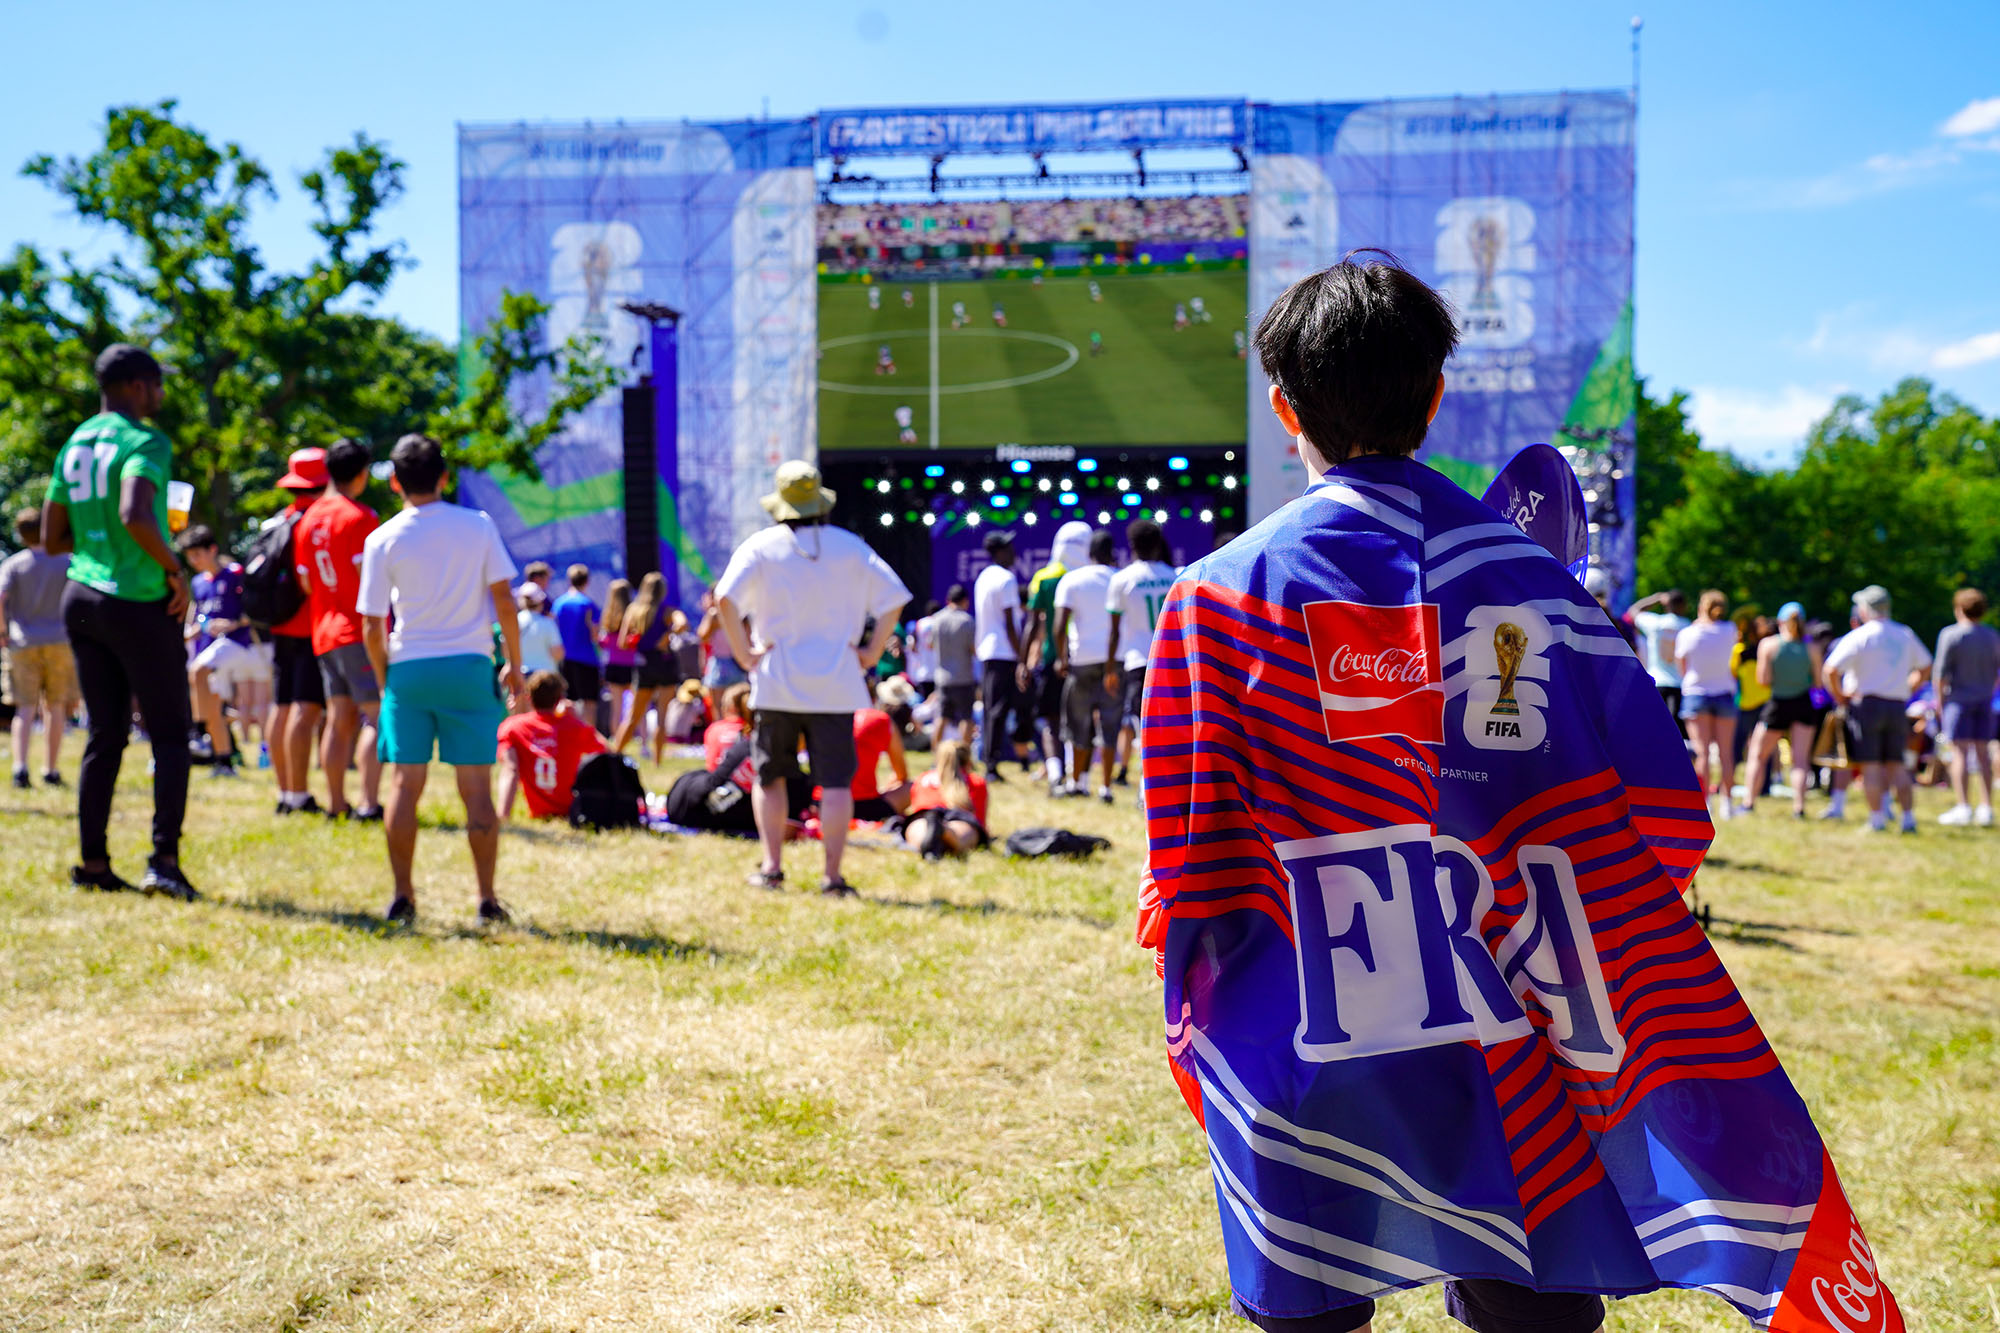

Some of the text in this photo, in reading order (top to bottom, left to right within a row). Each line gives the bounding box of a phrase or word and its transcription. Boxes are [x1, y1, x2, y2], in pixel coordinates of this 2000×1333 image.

[1485, 721, 1522, 738] FIFA
[1394, 757, 1489, 783] OFFICIAL PARTNER
[1276, 828, 1622, 1068] FRA
